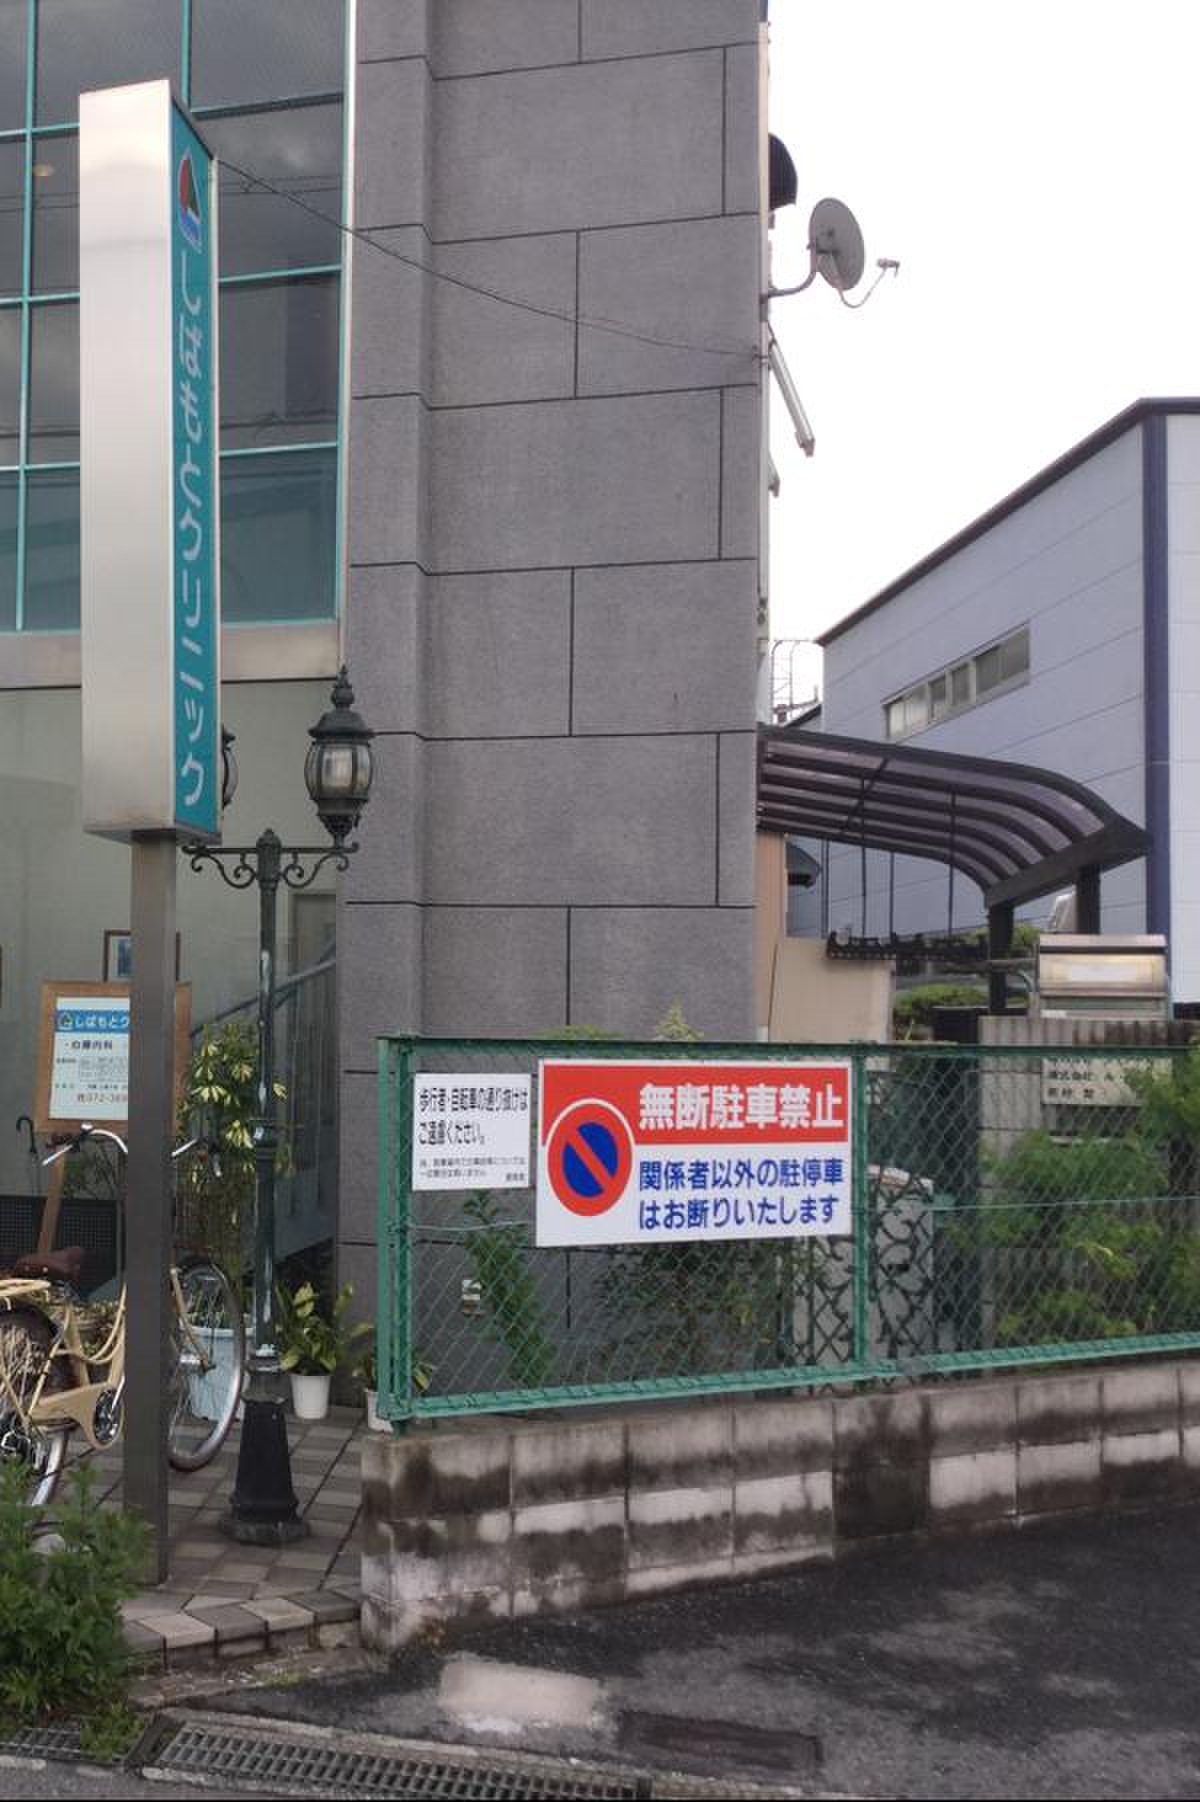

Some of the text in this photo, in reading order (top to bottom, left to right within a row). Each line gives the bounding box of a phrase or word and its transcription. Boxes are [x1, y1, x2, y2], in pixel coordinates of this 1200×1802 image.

[177, 250, 205, 807] しばもとクリニック
[639, 1083, 844, 1129] 無断駐車禁止
[639, 1158, 843, 1190] 関係者以外の駐停車
[639, 1196, 839, 1231] はお断りいたします
